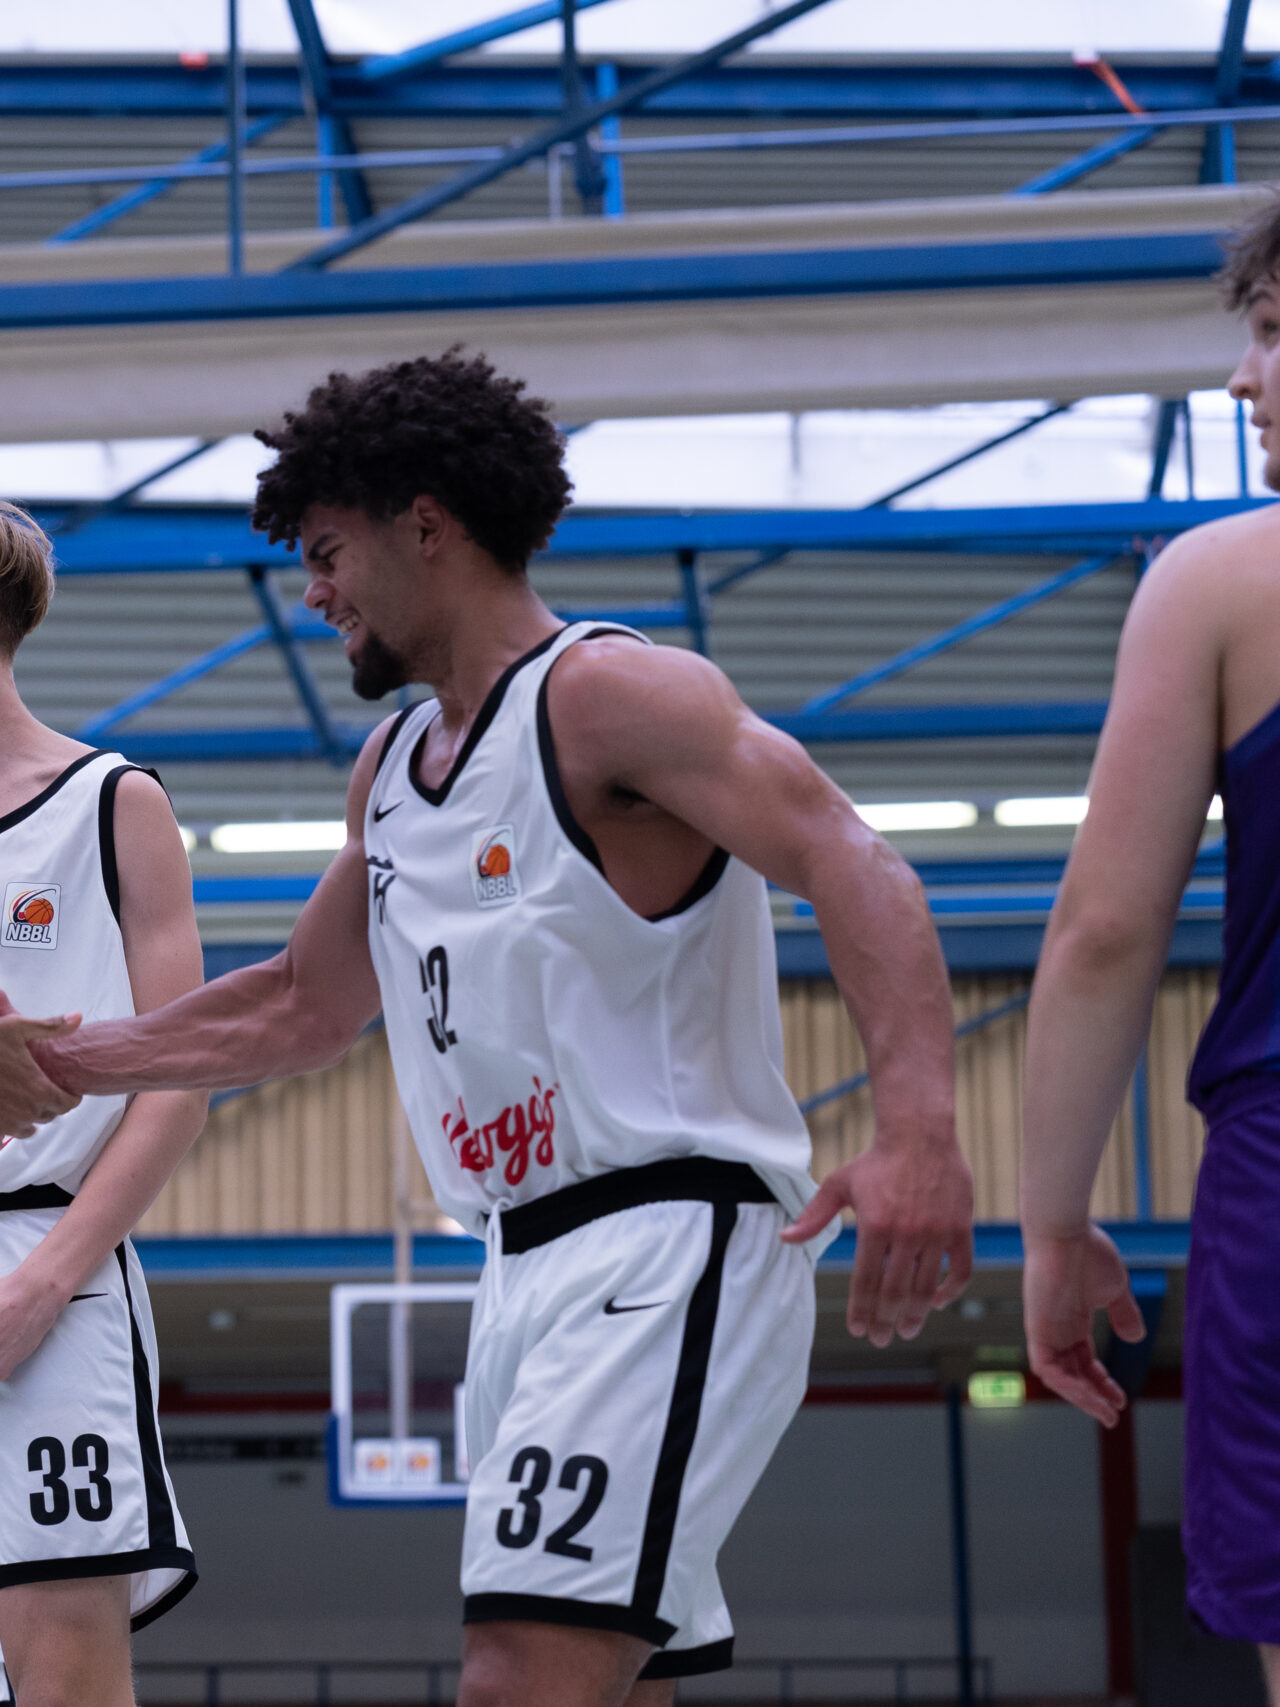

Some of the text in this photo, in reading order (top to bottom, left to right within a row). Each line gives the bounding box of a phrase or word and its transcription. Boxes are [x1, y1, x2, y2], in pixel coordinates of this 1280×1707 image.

[6, 922, 52, 944] NBBL
[26, 1433, 113, 1525] 33
[496, 1446, 609, 1562] 32
